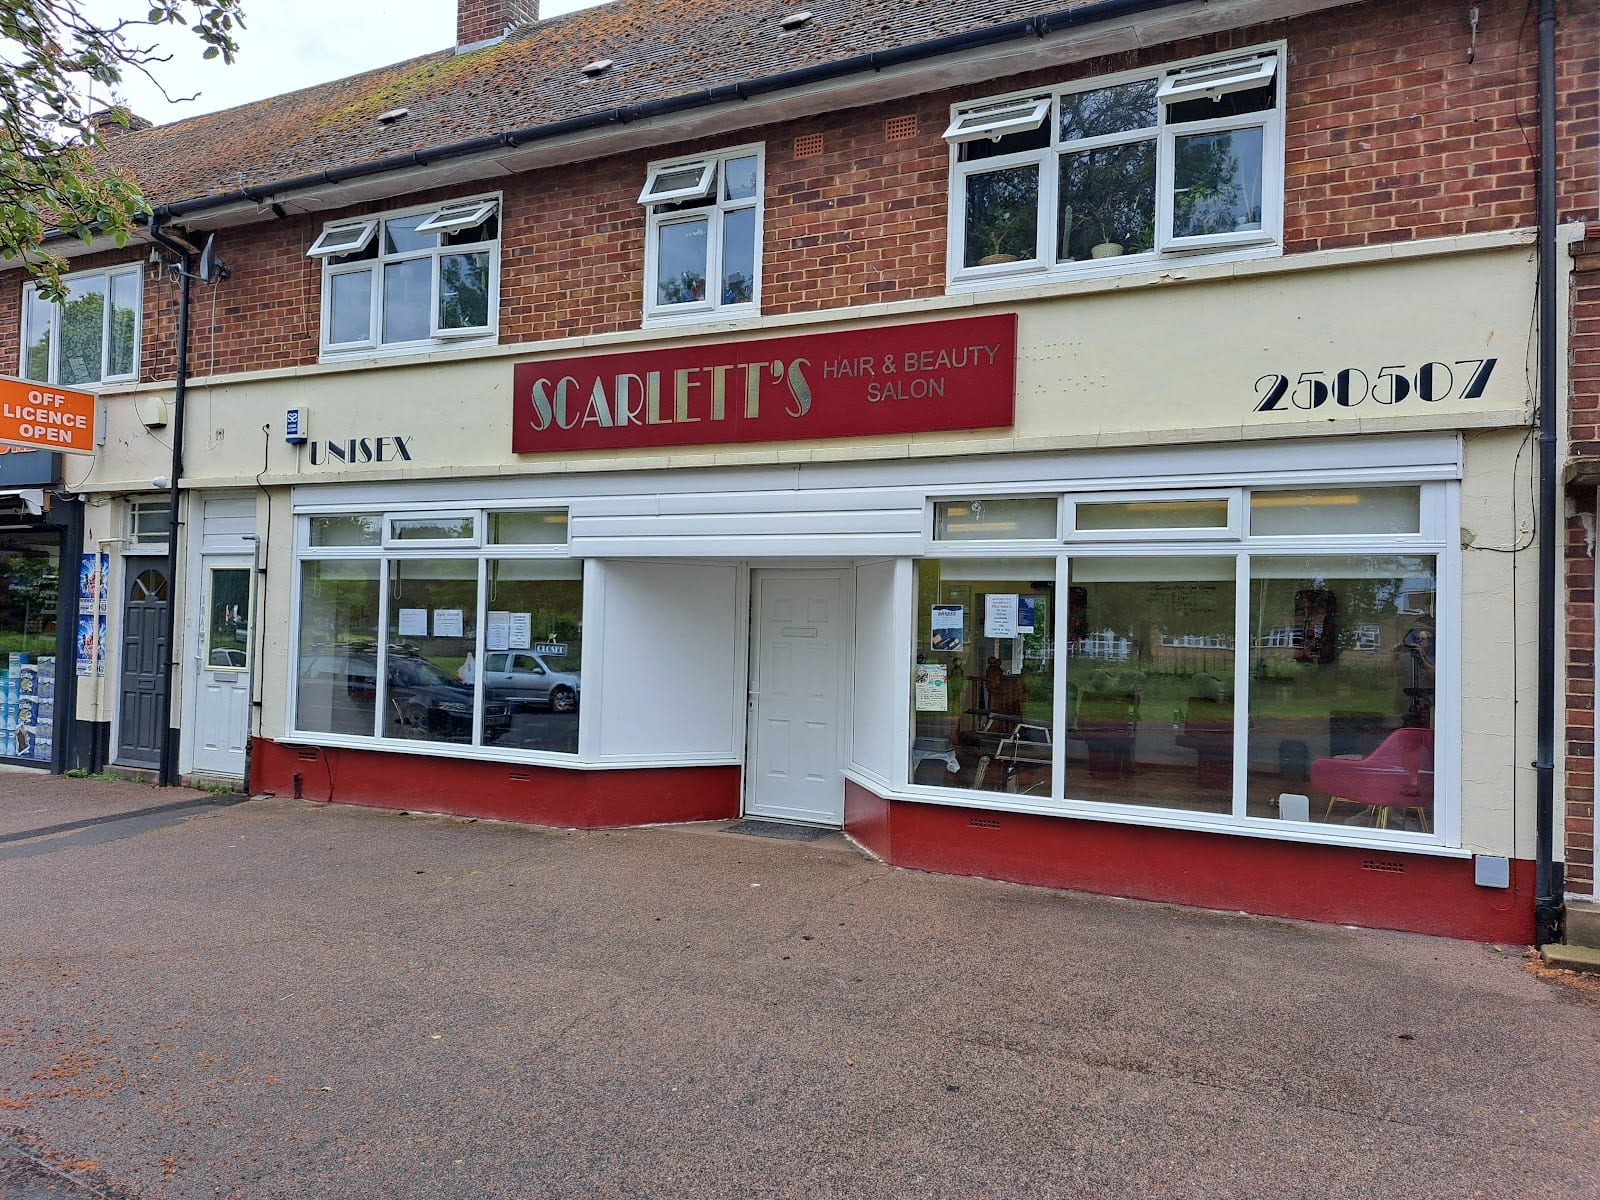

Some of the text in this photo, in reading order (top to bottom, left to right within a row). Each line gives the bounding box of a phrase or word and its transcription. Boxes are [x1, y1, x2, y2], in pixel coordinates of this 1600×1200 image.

[823, 344, 1000, 379] HAIR & BEAUTY
[28, 390, 65, 408] OFF
[530, 358, 811, 431] SCARLETT'S
[867, 377, 945, 402] SALON
[1253, 358, 1498, 412] 250507
[3, 403, 87, 429] LICENCE
[19, 423, 72, 443] OPEN
[309, 435, 413, 466] UNISEX
